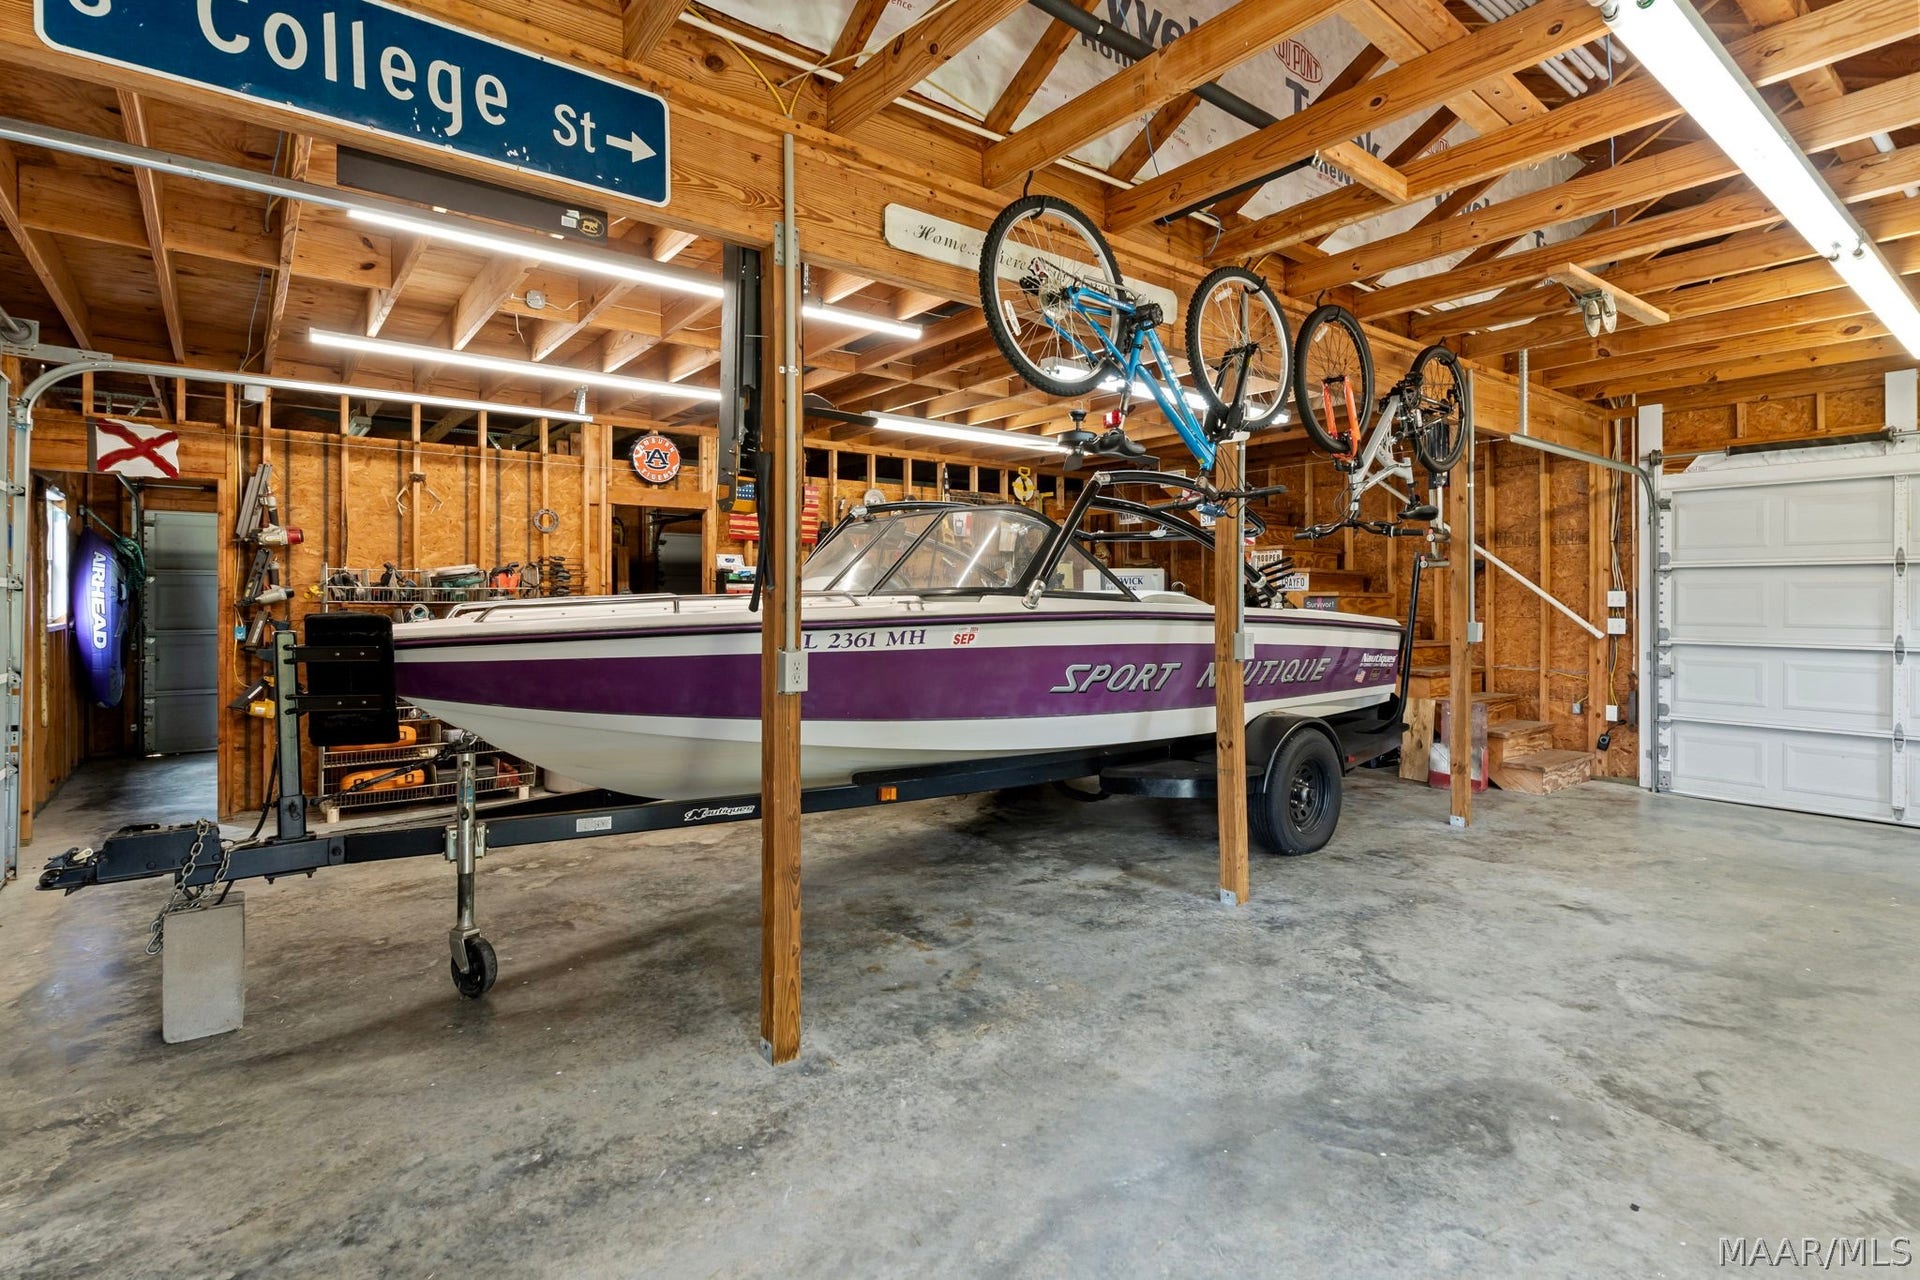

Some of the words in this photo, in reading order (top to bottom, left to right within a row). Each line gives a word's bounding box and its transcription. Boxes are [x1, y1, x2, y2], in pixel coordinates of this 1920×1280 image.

[197, 0, 508, 136] College
[553, 103, 597, 153] St
[91, 551, 108, 650] AIRHEAD
[827, 631, 877, 650] 2361
[885, 629, 927, 647] MH
[953, 633, 975, 645] SEP
[1050, 662, 1182, 693] SPORT
[1196, 657, 1332, 689] NUTIQUE
